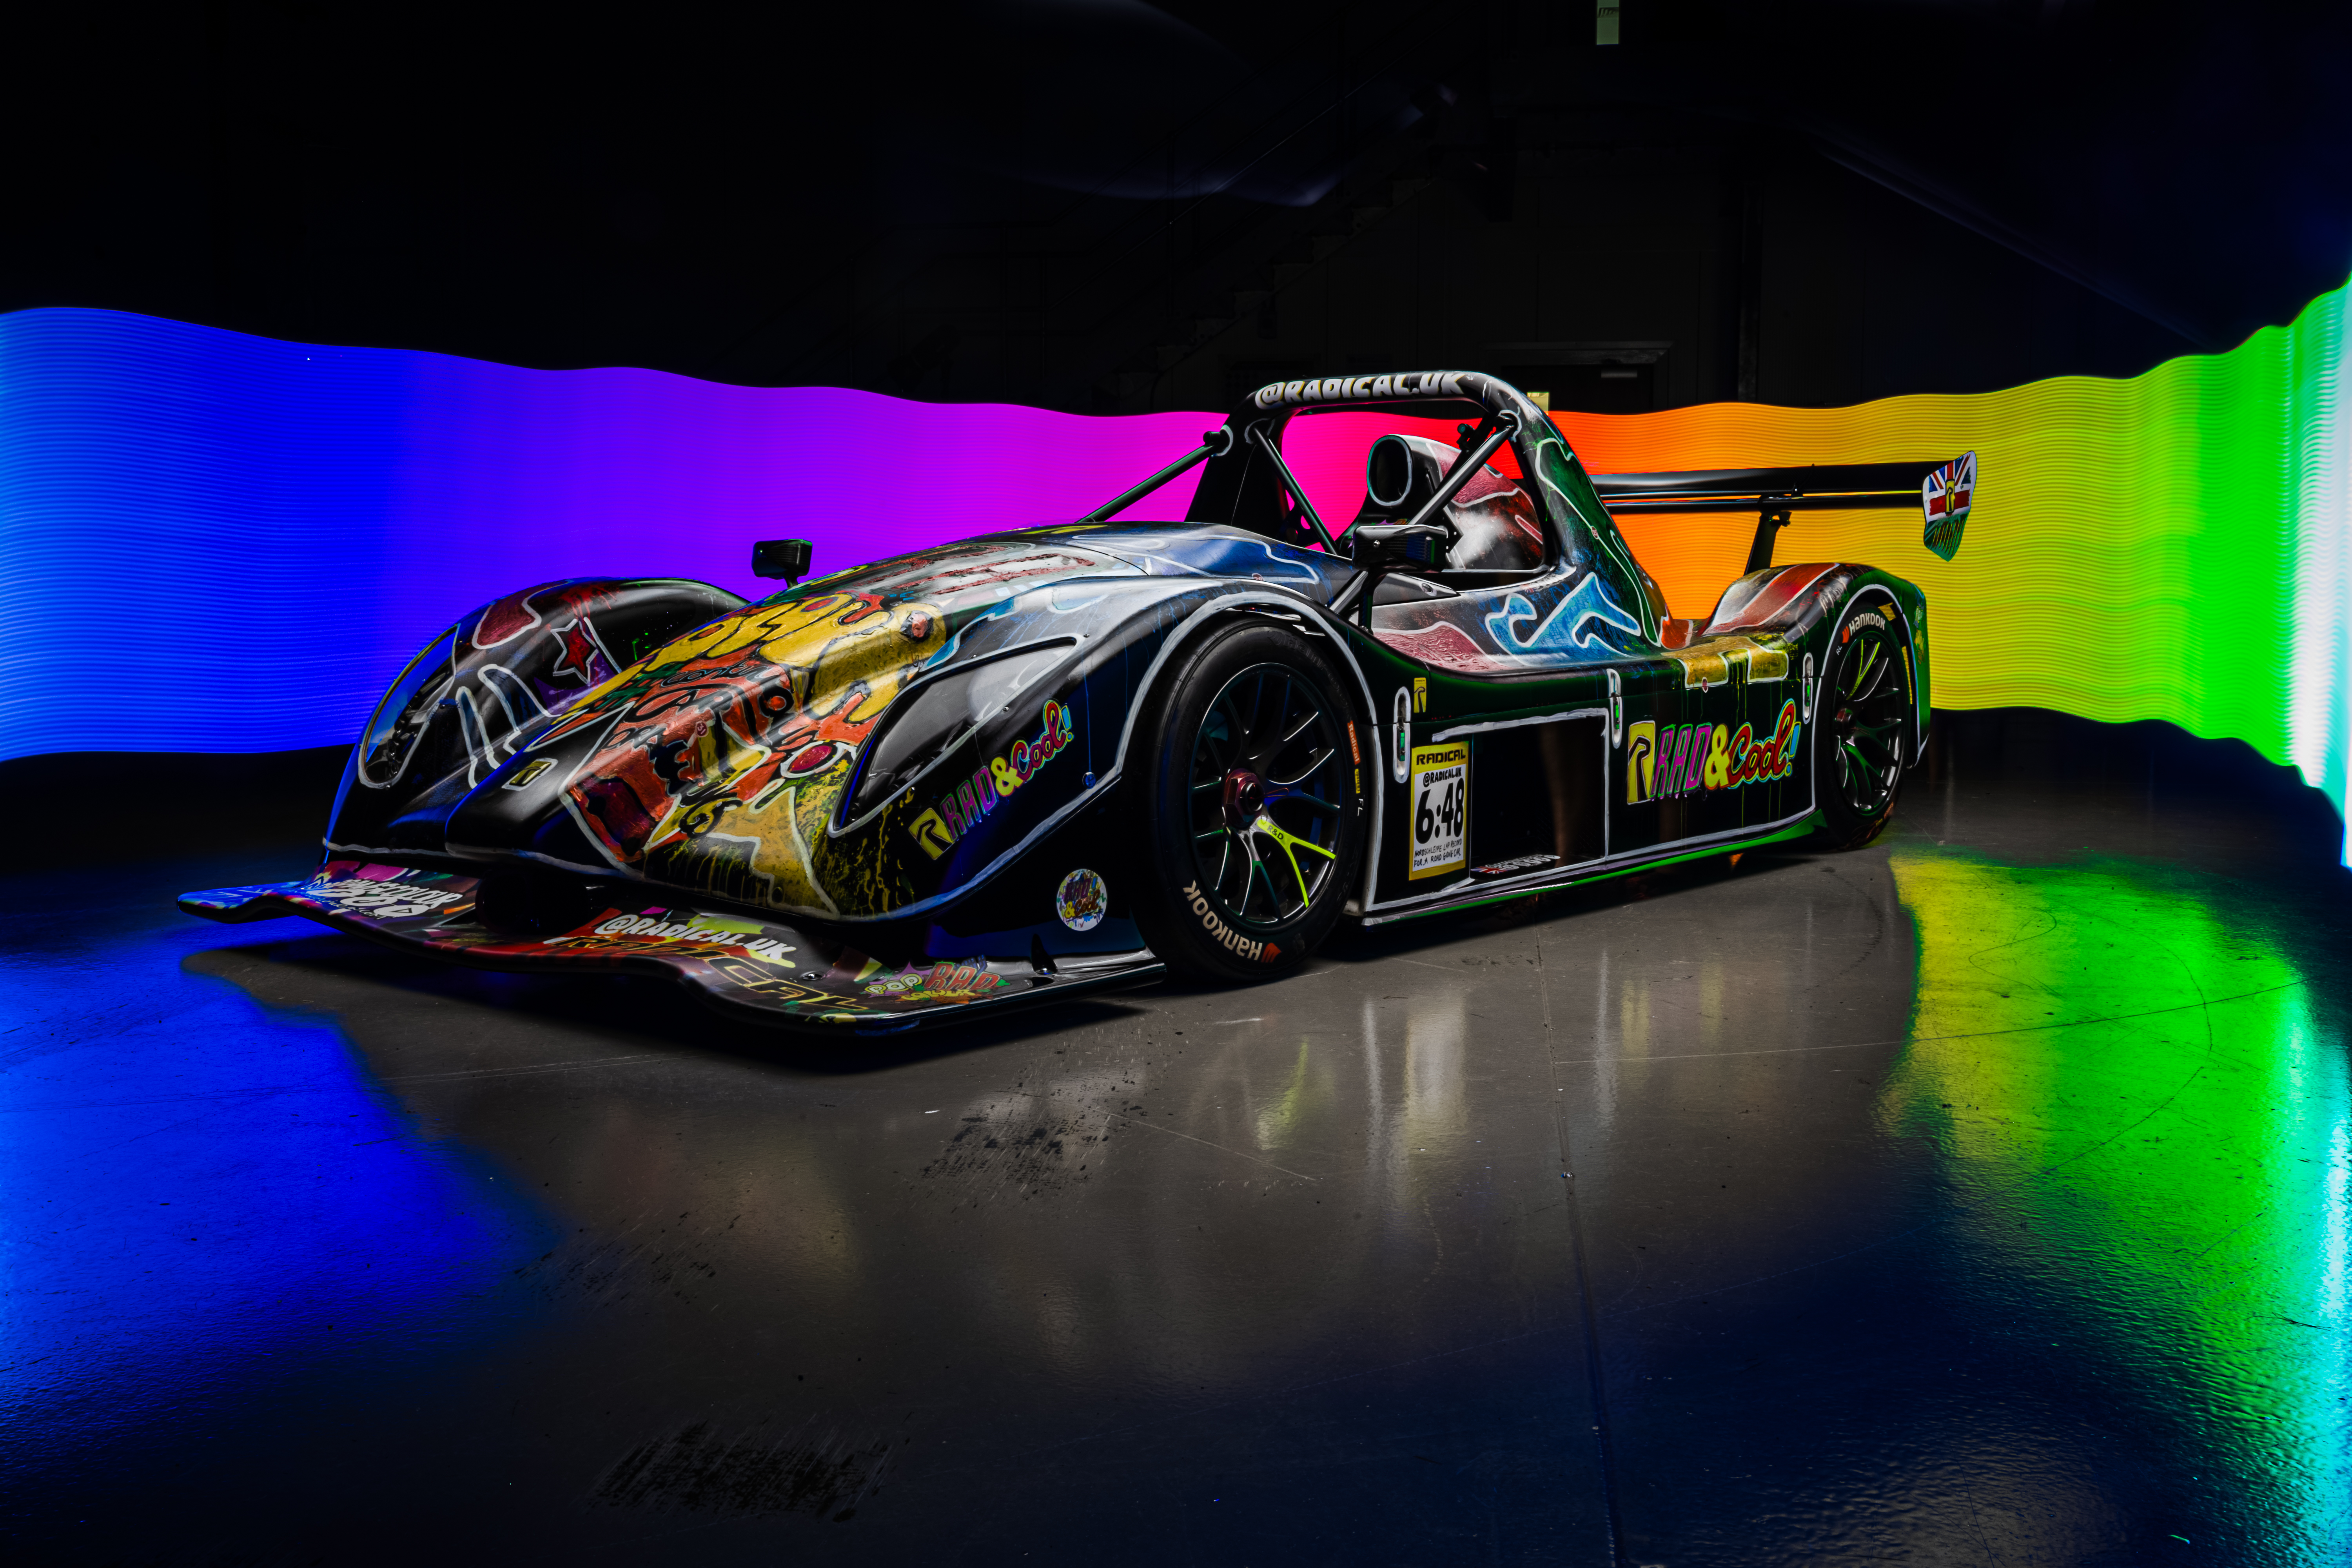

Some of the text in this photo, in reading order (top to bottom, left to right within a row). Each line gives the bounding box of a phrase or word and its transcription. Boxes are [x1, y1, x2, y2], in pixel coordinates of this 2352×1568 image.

[1255, 372, 1466, 409] @RADICAL.UK
[1849, 613, 1886, 636] Hankook
[1348, 723, 1360, 762] Radical
[1416, 749, 1466, 766] RADICAL
[1423, 766, 1462, 788] @RADICAL.UK
[1416, 777, 1465, 844] 6:48
[1267, 825, 1284, 840] R&D
[1423, 857, 1428, 866] A
[1431, 854, 1442, 863] ROAD
[594, 914, 797, 960] @RADICAL.UK
[1183, 879, 1263, 961] Hankook
[864, 961, 1004, 995] POP RAD
